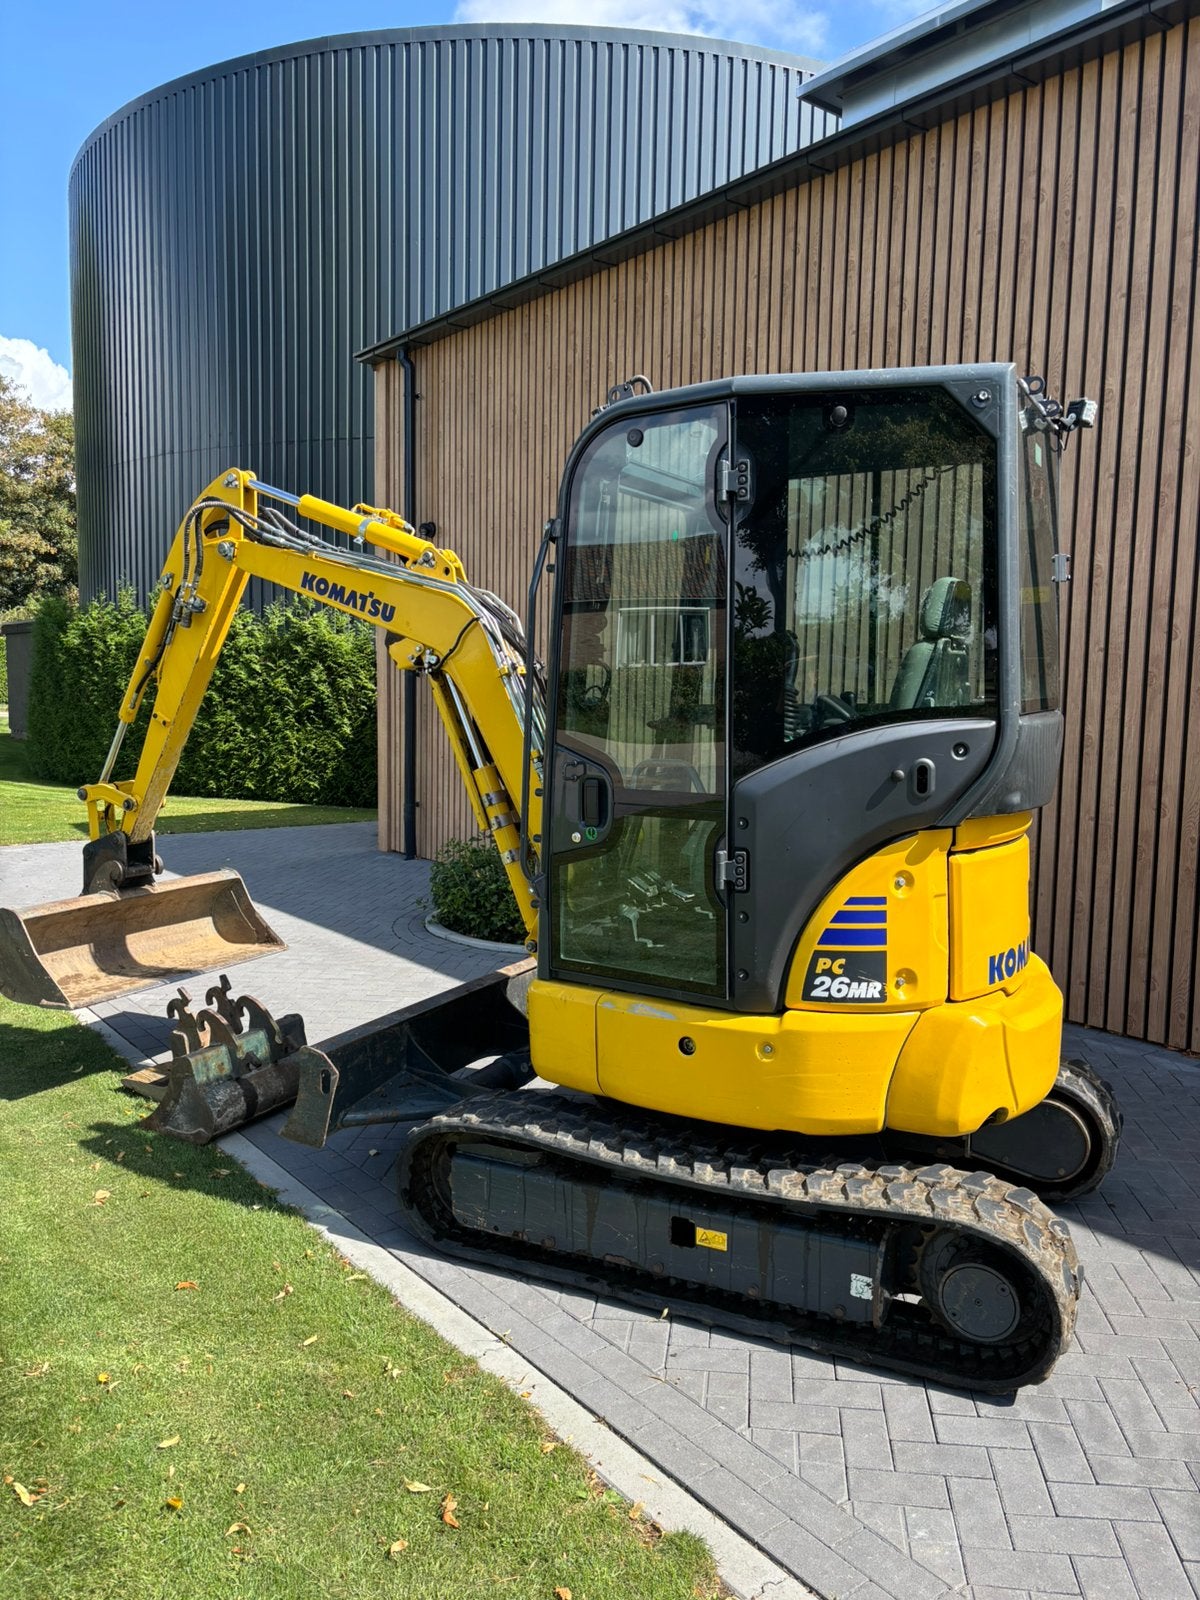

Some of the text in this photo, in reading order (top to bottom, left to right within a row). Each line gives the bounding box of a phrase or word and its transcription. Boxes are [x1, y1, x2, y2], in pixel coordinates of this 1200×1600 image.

[301, 571, 396, 622] KOMATSU
[815, 958, 846, 975] PC
[988, 937, 1029, 985] KOM
[810, 976, 882, 998] 26MR
